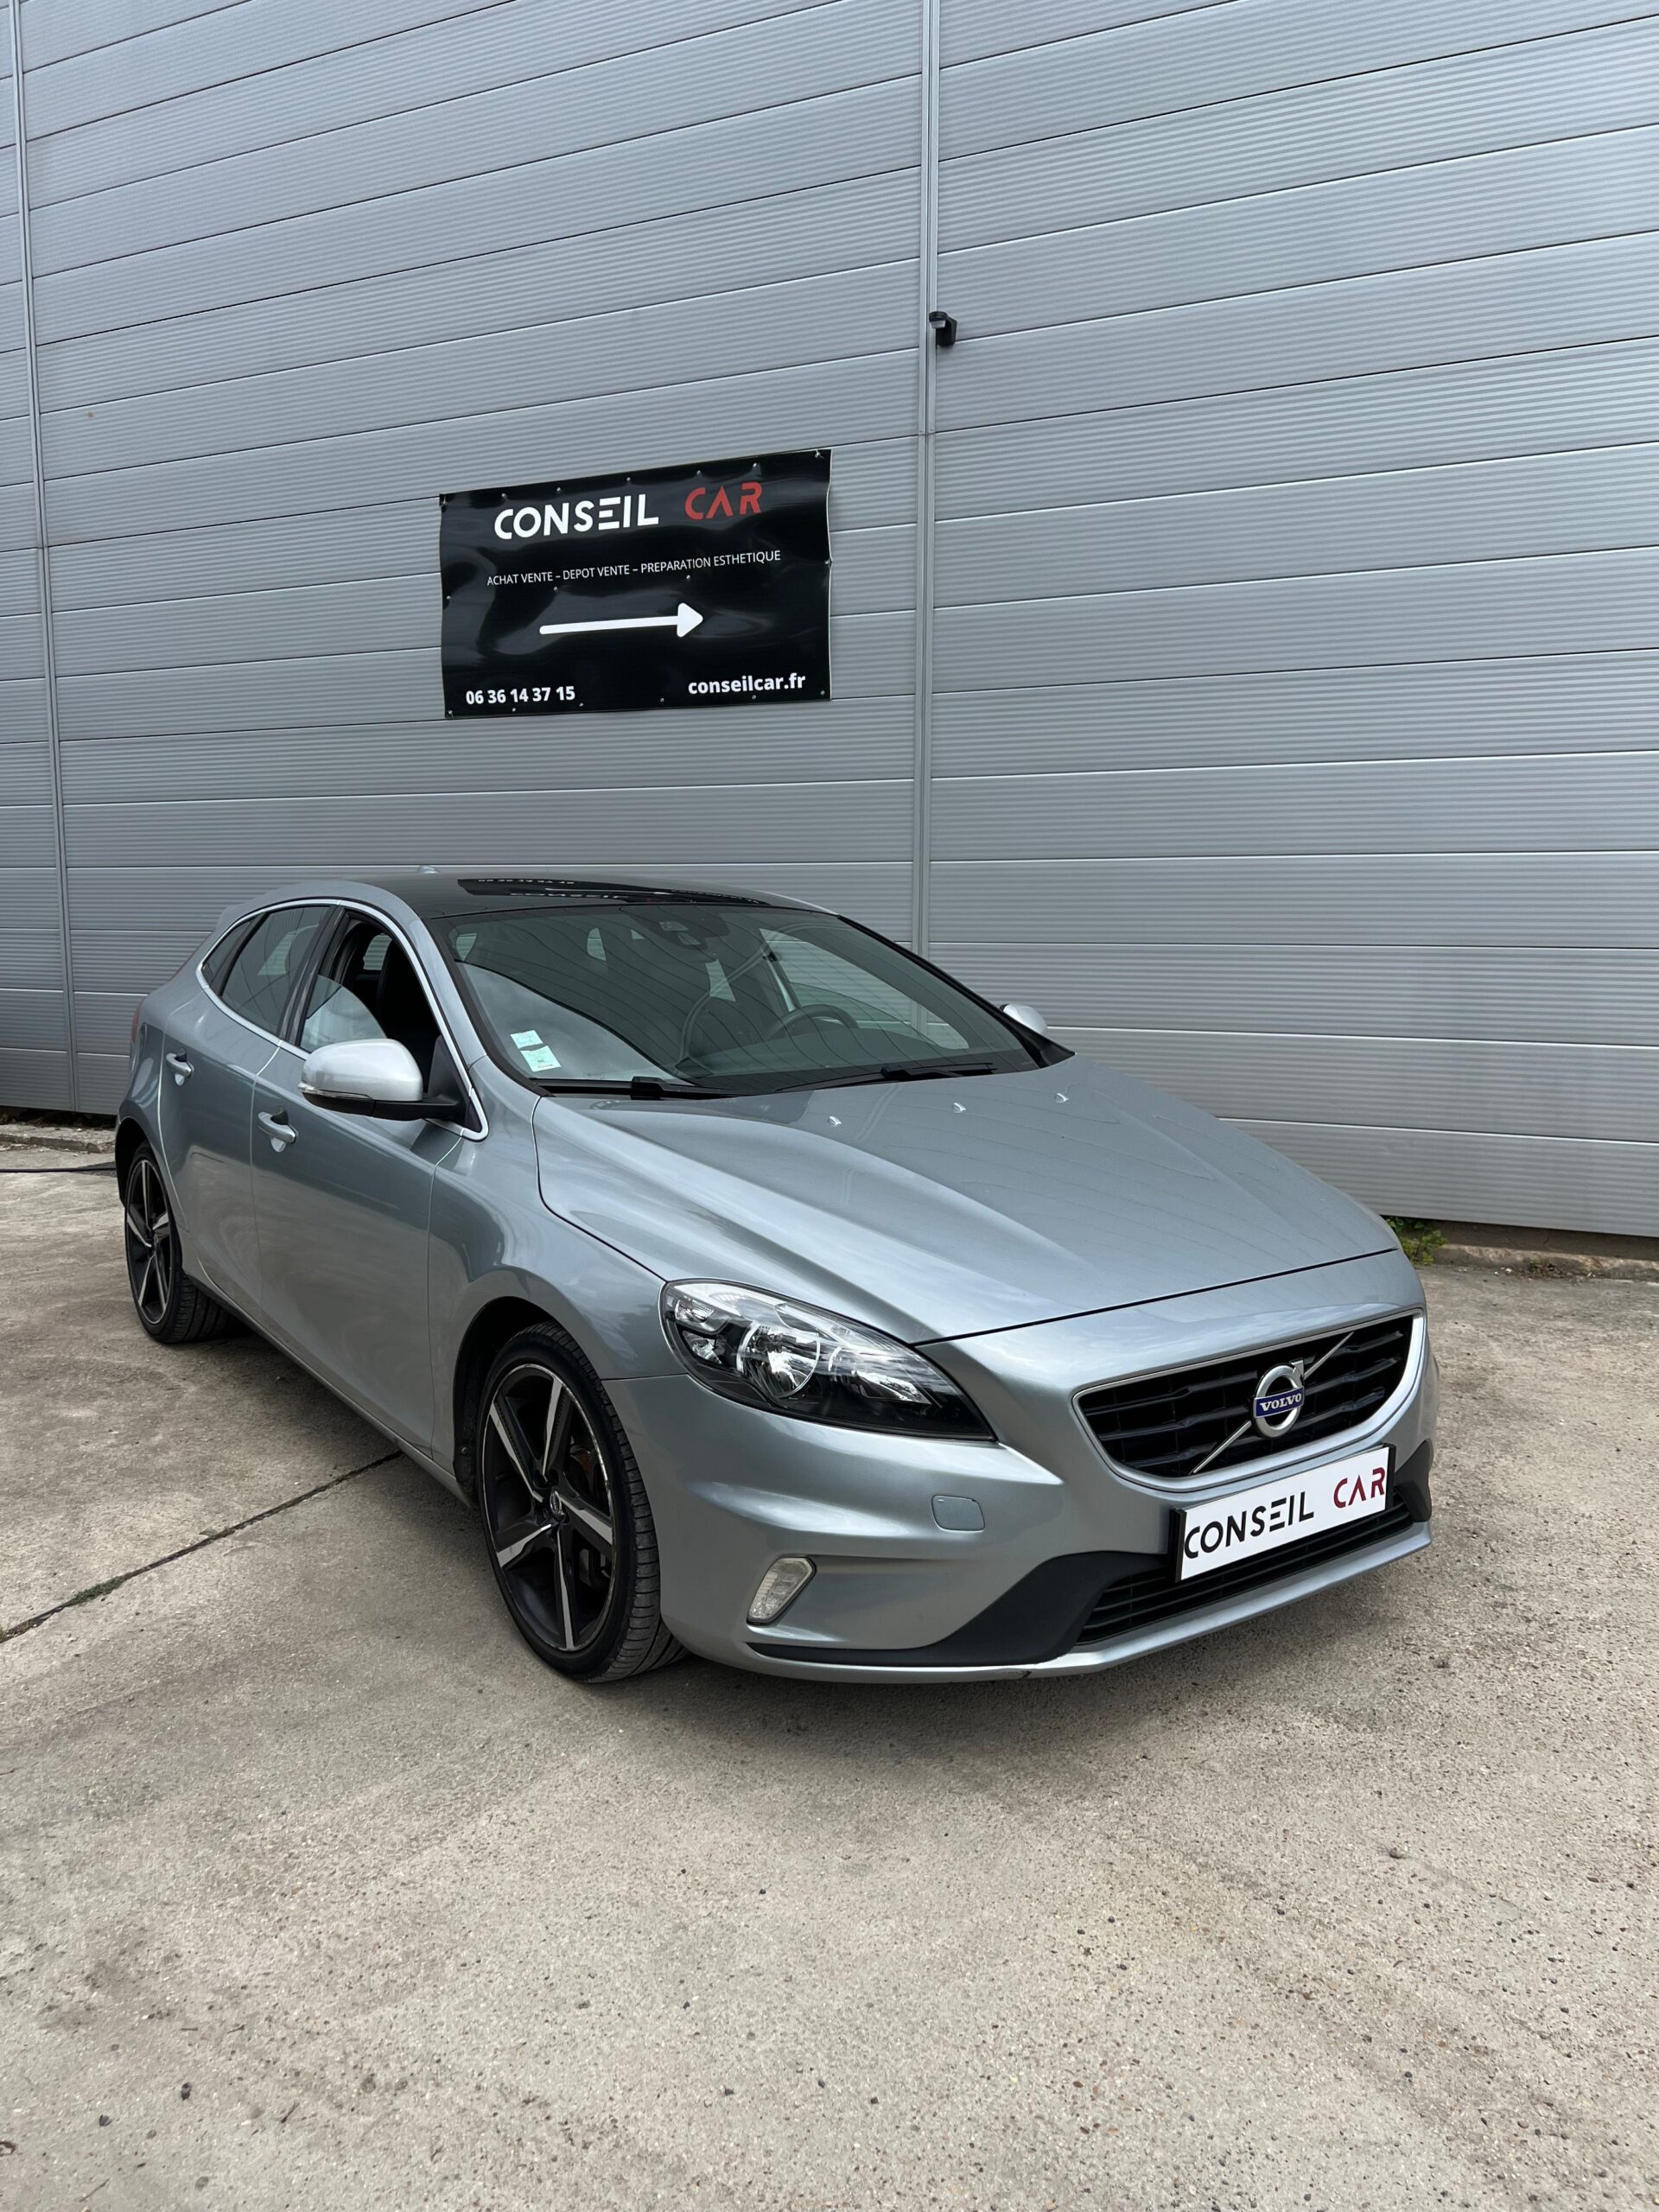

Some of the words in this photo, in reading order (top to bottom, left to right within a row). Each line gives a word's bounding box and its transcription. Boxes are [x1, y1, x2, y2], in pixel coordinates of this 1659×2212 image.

[493, 493, 659, 540] CONSEIL
[684, 481, 763, 521] CAR
[486, 574, 519, 587] ACHAT
[520, 571, 554, 583] VENTE
[563, 567, 596, 581] DEPOT
[597, 564, 631, 577] VENTE
[640, 556, 712, 574] PREPARATION
[713, 550, 782, 567] ESTHETIQUE
[465, 690, 485, 705] 06
[486, 689, 506, 704] 36
[510, 688, 529, 703] 14
[531, 686, 551, 702] 37
[555, 685, 576, 701] 15
[688, 672, 806, 695] conseilcar.fr
[1259, 1392, 1303, 1412] VOLVO
[1184, 1491, 1314, 1559] CONSEIL
[1333, 1467, 1385, 1509] CAR
